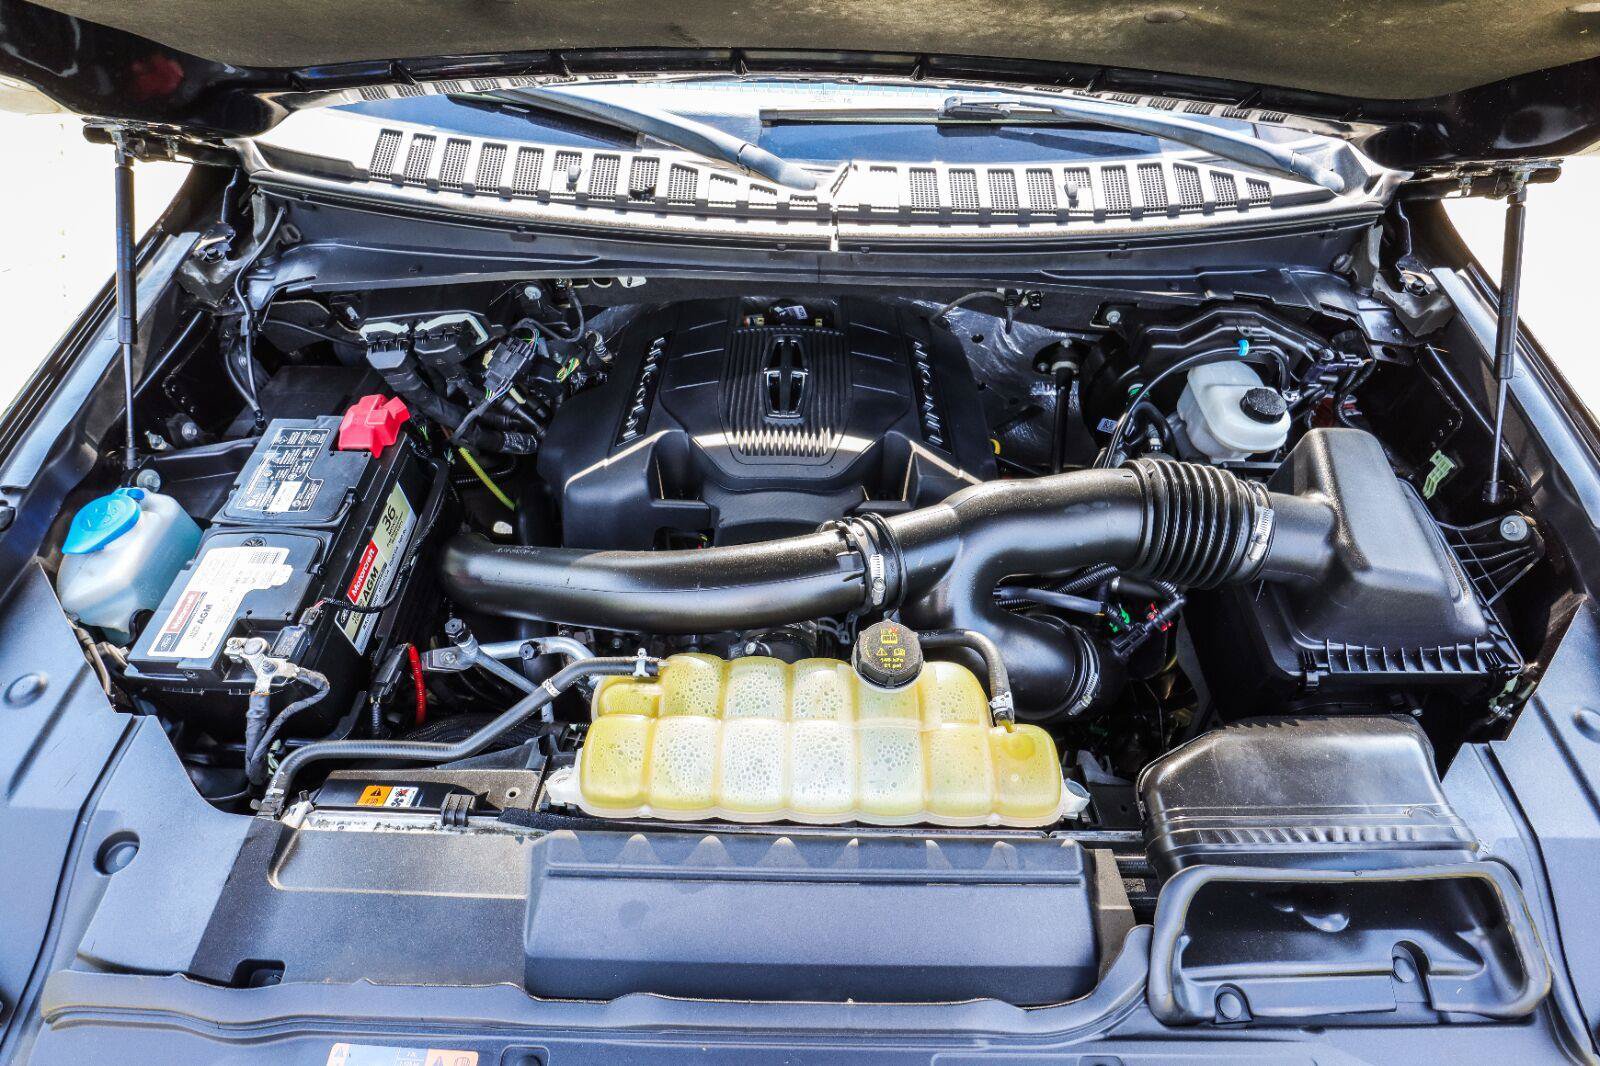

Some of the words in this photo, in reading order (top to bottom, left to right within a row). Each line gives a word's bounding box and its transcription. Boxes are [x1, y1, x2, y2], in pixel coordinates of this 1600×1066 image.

[623, 337, 666, 441] LINCOLN
[382, 504, 396, 532] 36
[351, 548, 376, 597] Motorcraft
[363, 565, 379, 602] AGM
